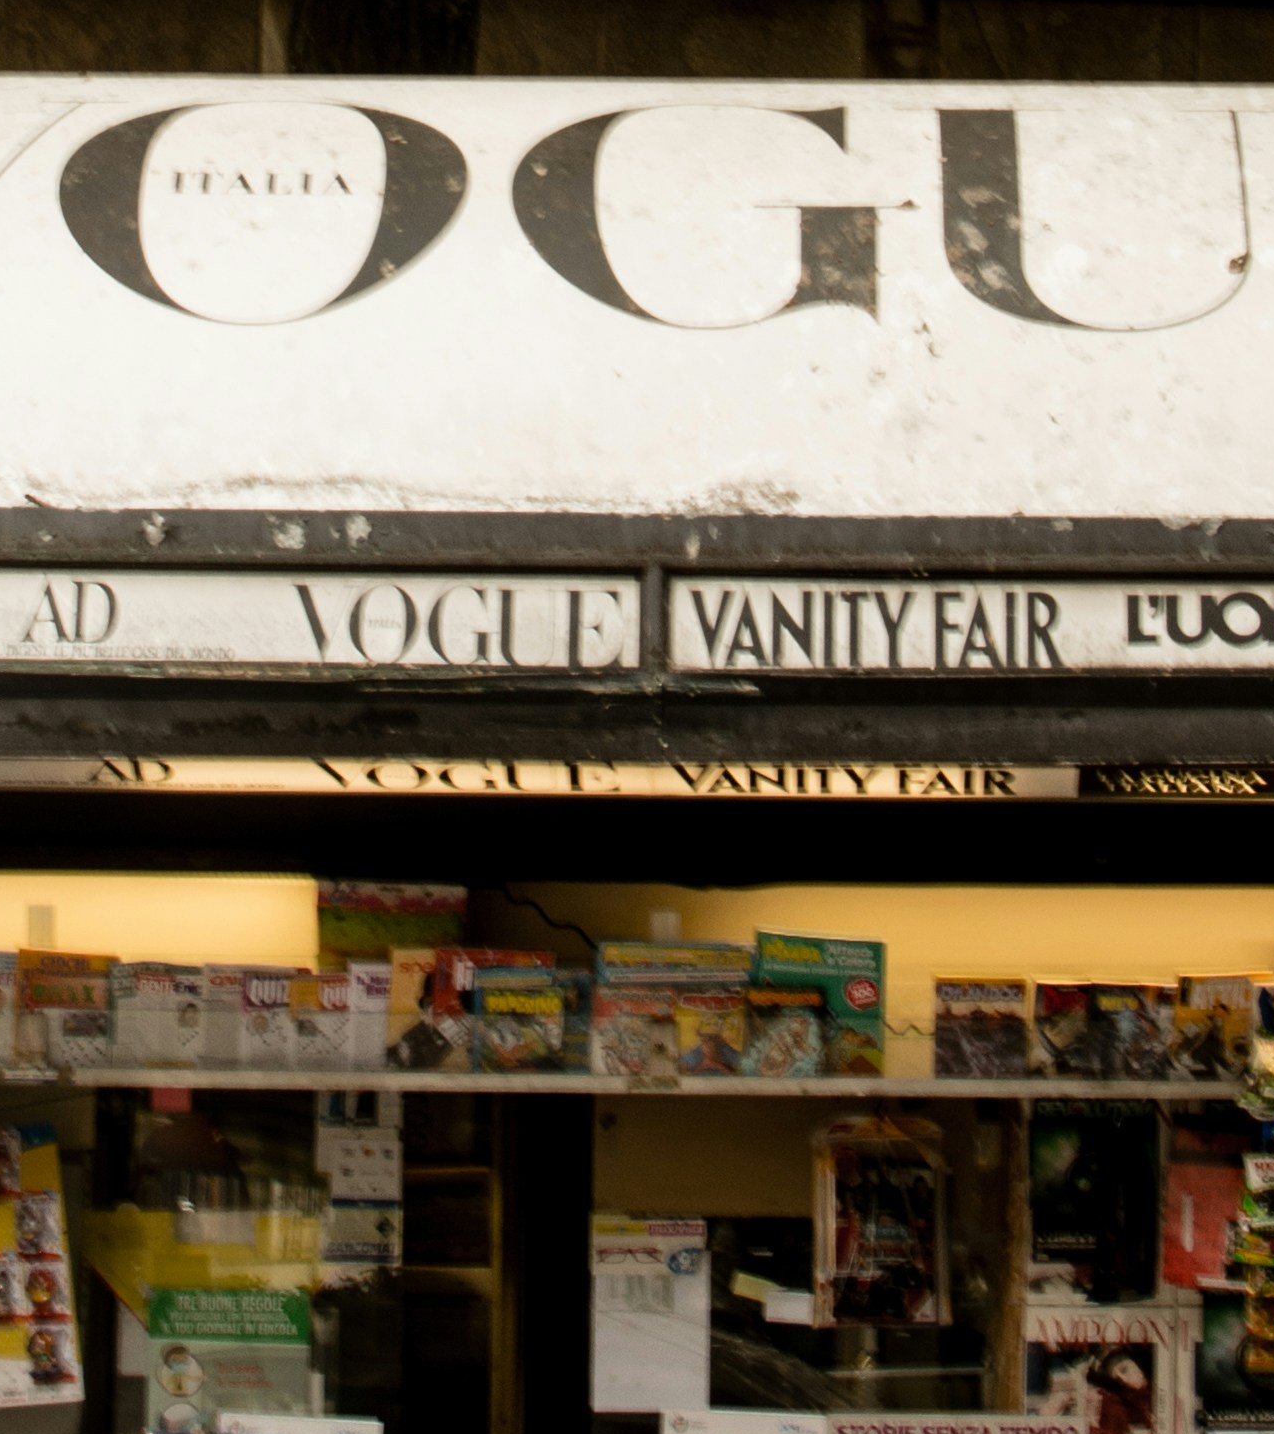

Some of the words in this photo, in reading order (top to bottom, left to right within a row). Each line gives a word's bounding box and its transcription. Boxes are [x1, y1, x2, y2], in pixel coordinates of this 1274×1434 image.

[170, 169, 353, 196] ITALIA
[22, 580, 122, 644] AD
[292, 583, 622, 669] VOGUE
[690, 590, 916, 669] VANITY
[935, 591, 1063, 669] FAIR
[190, 647, 236, 661] MONDO
[88, 752, 176, 783] AD
[312, 757, 622, 793] VOGUE
[672, 763, 886, 795] VANITY
[897, 765, 1018, 796] FAIR
